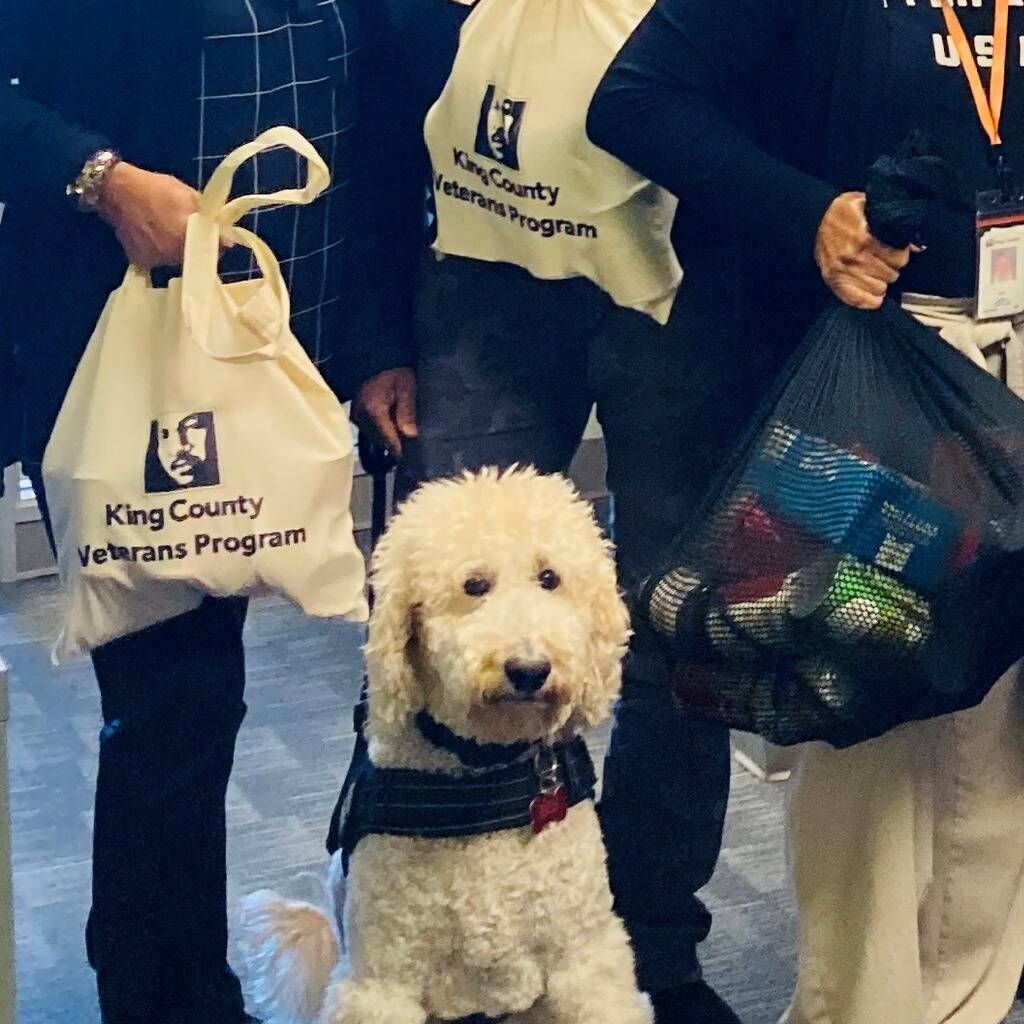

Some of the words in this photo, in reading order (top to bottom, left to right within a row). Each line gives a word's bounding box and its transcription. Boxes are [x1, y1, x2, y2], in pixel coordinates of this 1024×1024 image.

[453, 147, 490, 186] King
[489, 167, 559, 206] County
[434, 173, 507, 218] Veterans
[508, 204, 597, 238] Program
[105, 503, 164, 531] King
[169, 495, 264, 521] County
[77, 542, 188, 568] Veterans
[194, 527, 307, 557] Program
